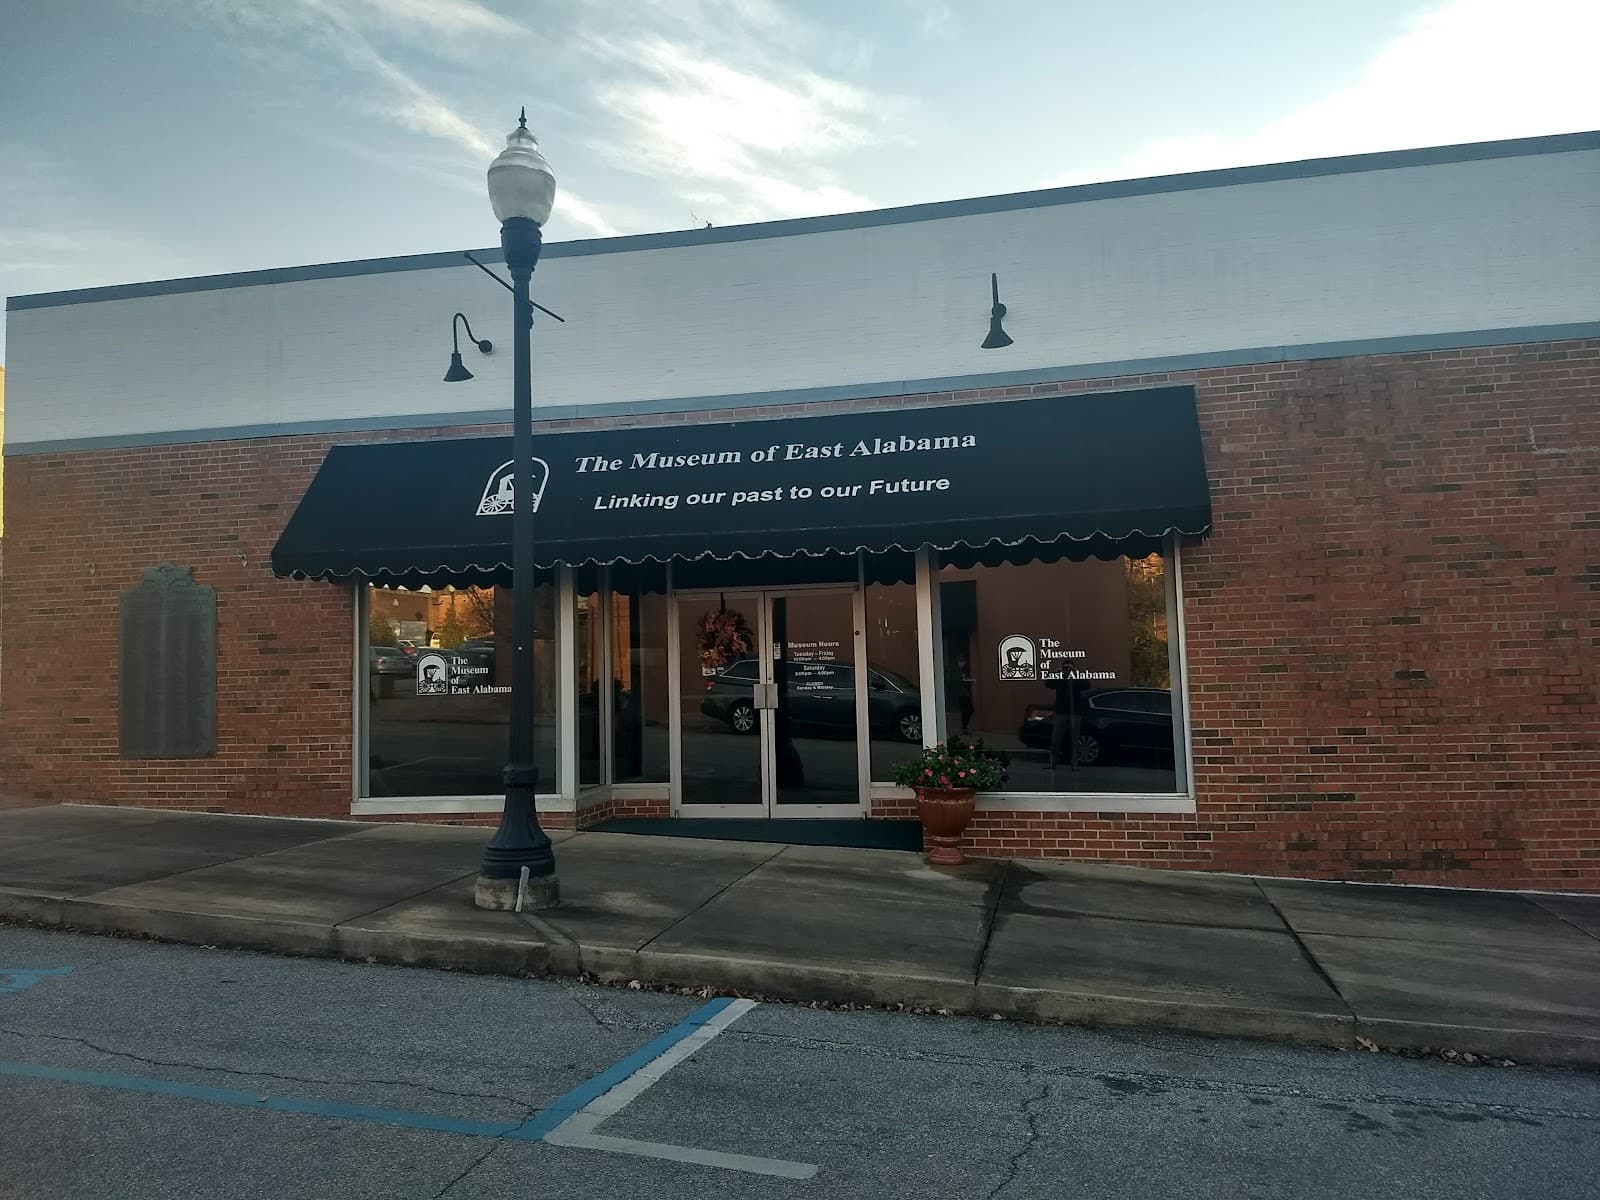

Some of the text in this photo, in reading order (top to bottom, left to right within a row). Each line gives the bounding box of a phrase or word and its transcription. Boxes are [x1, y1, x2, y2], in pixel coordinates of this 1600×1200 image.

[575, 435, 977, 473] The Museum of East Alabama
[594, 478, 950, 510] Linking our past to our Future
[1039, 638, 1060, 648] The
[1039, 649, 1086, 658] Museum
[451, 656, 468, 665] The
[1040, 660, 1051, 669] of
[451, 666, 489, 675] Museum
[1041, 670, 1116, 680] East Alabama
[450, 675, 460, 685] of
[451, 685, 512, 695] East Alabama
